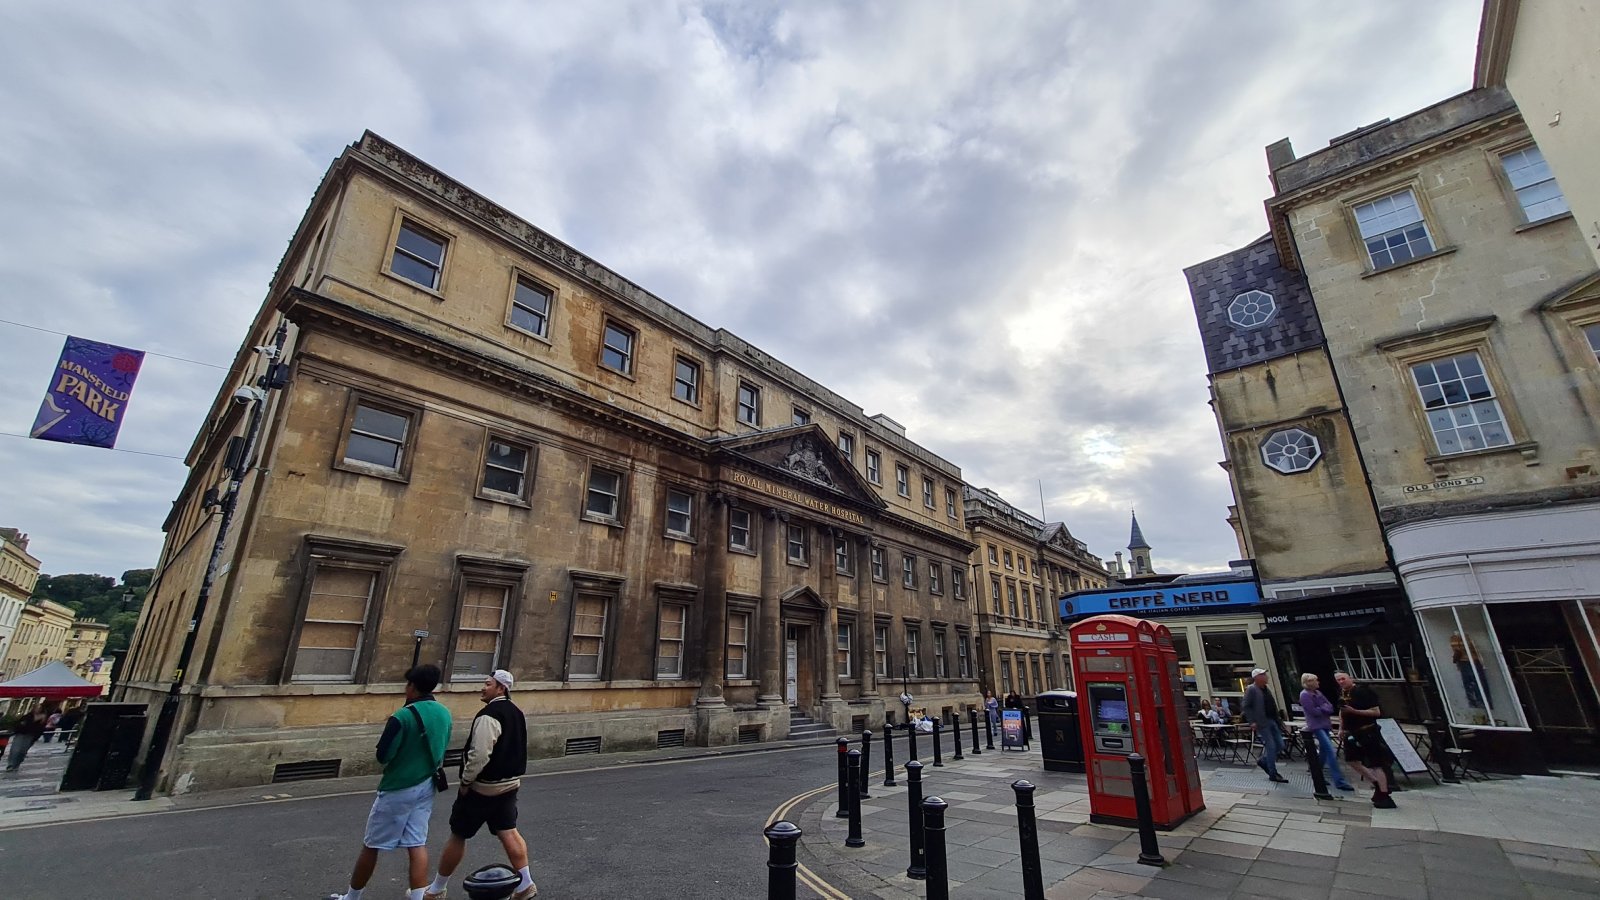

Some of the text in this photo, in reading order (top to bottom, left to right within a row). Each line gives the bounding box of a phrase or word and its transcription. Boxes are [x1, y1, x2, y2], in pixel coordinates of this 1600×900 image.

[60, 360, 129, 401] MANSFIELD
[56, 373, 120, 422] PARK
[734, 473, 864, 524] ROYAL MINERAL WATER HOSPITAL
[1407, 484, 1428, 492] OLD
[1433, 480, 1462, 488] BOND
[1109, 590, 1230, 609] CAFFÈ NERO
[1091, 633, 1116, 641] CASH
